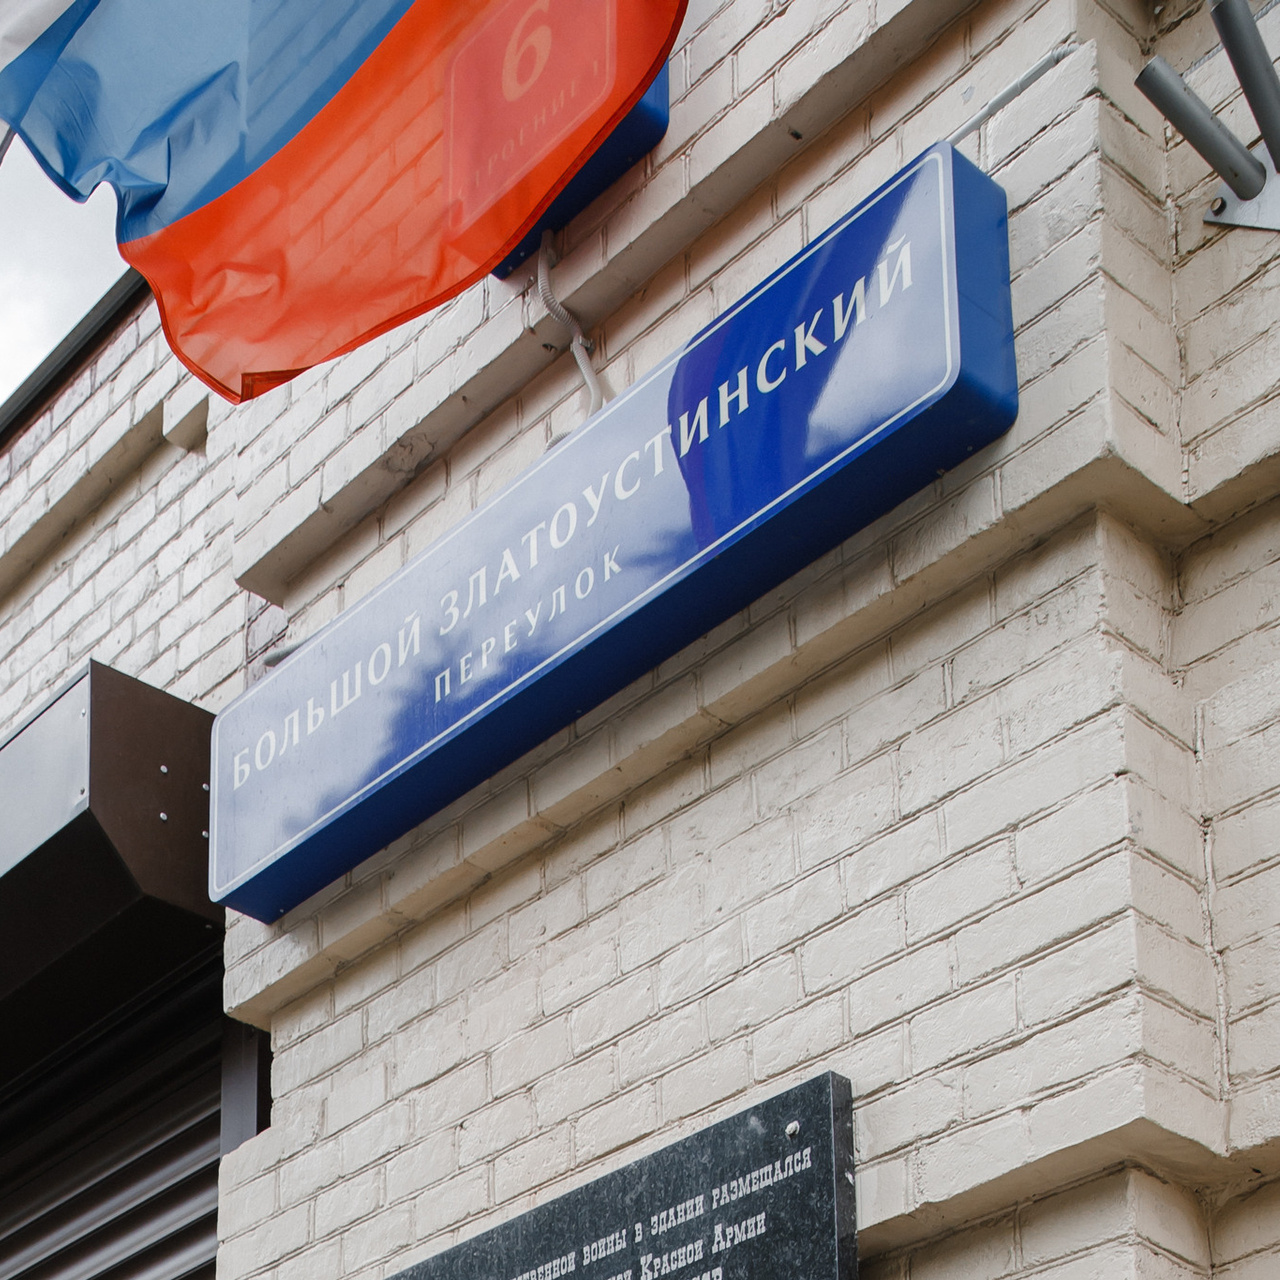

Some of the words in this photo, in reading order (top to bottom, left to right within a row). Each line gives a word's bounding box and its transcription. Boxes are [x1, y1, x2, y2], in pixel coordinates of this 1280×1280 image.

[232, 608, 422, 792] БОЛЬШОЙ
[439, 233, 914, 637] ЗЛАТОУСТИНСКИЙ
[434, 544, 623, 704] ПЕРЕУЛОК
